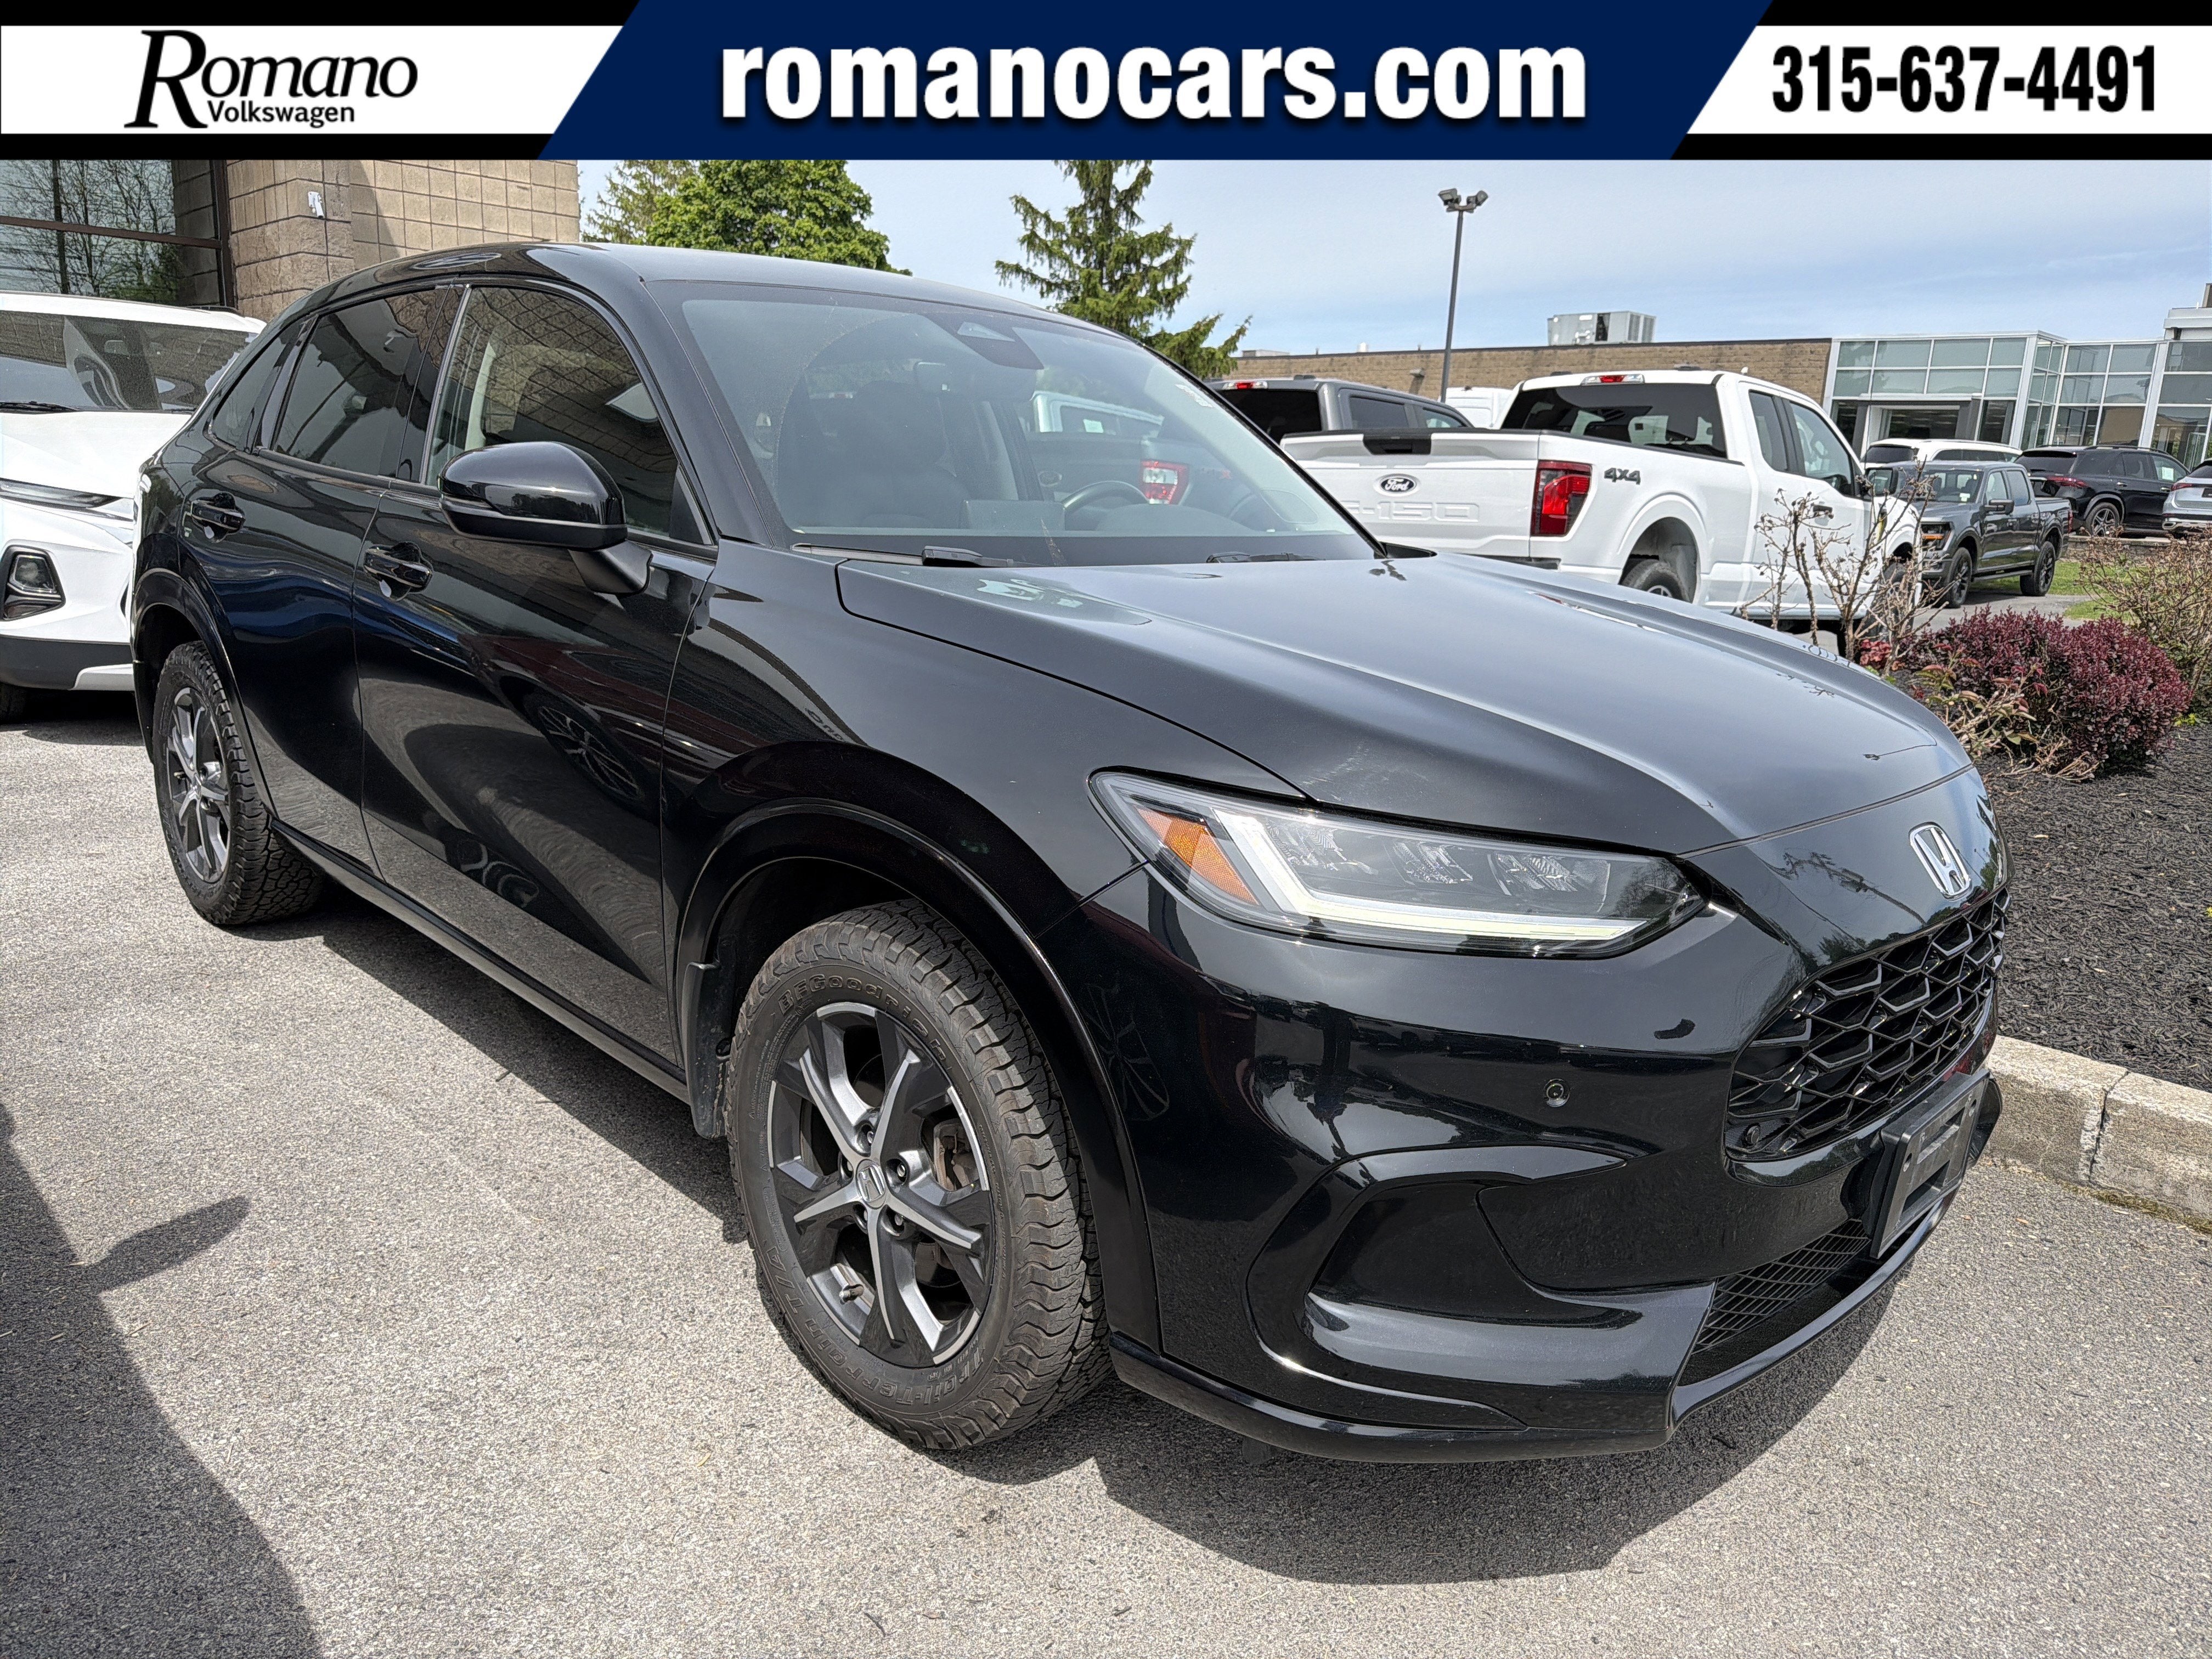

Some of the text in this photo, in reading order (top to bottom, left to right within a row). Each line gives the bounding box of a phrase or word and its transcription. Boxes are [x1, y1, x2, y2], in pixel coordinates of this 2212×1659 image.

[1384, 478, 1410, 492] Ford
[777, 973, 946, 1060] BFGoodrich
[766, 1246, 804, 1314] T/A
[804, 1318, 986, 1406] Trail-Terrain
